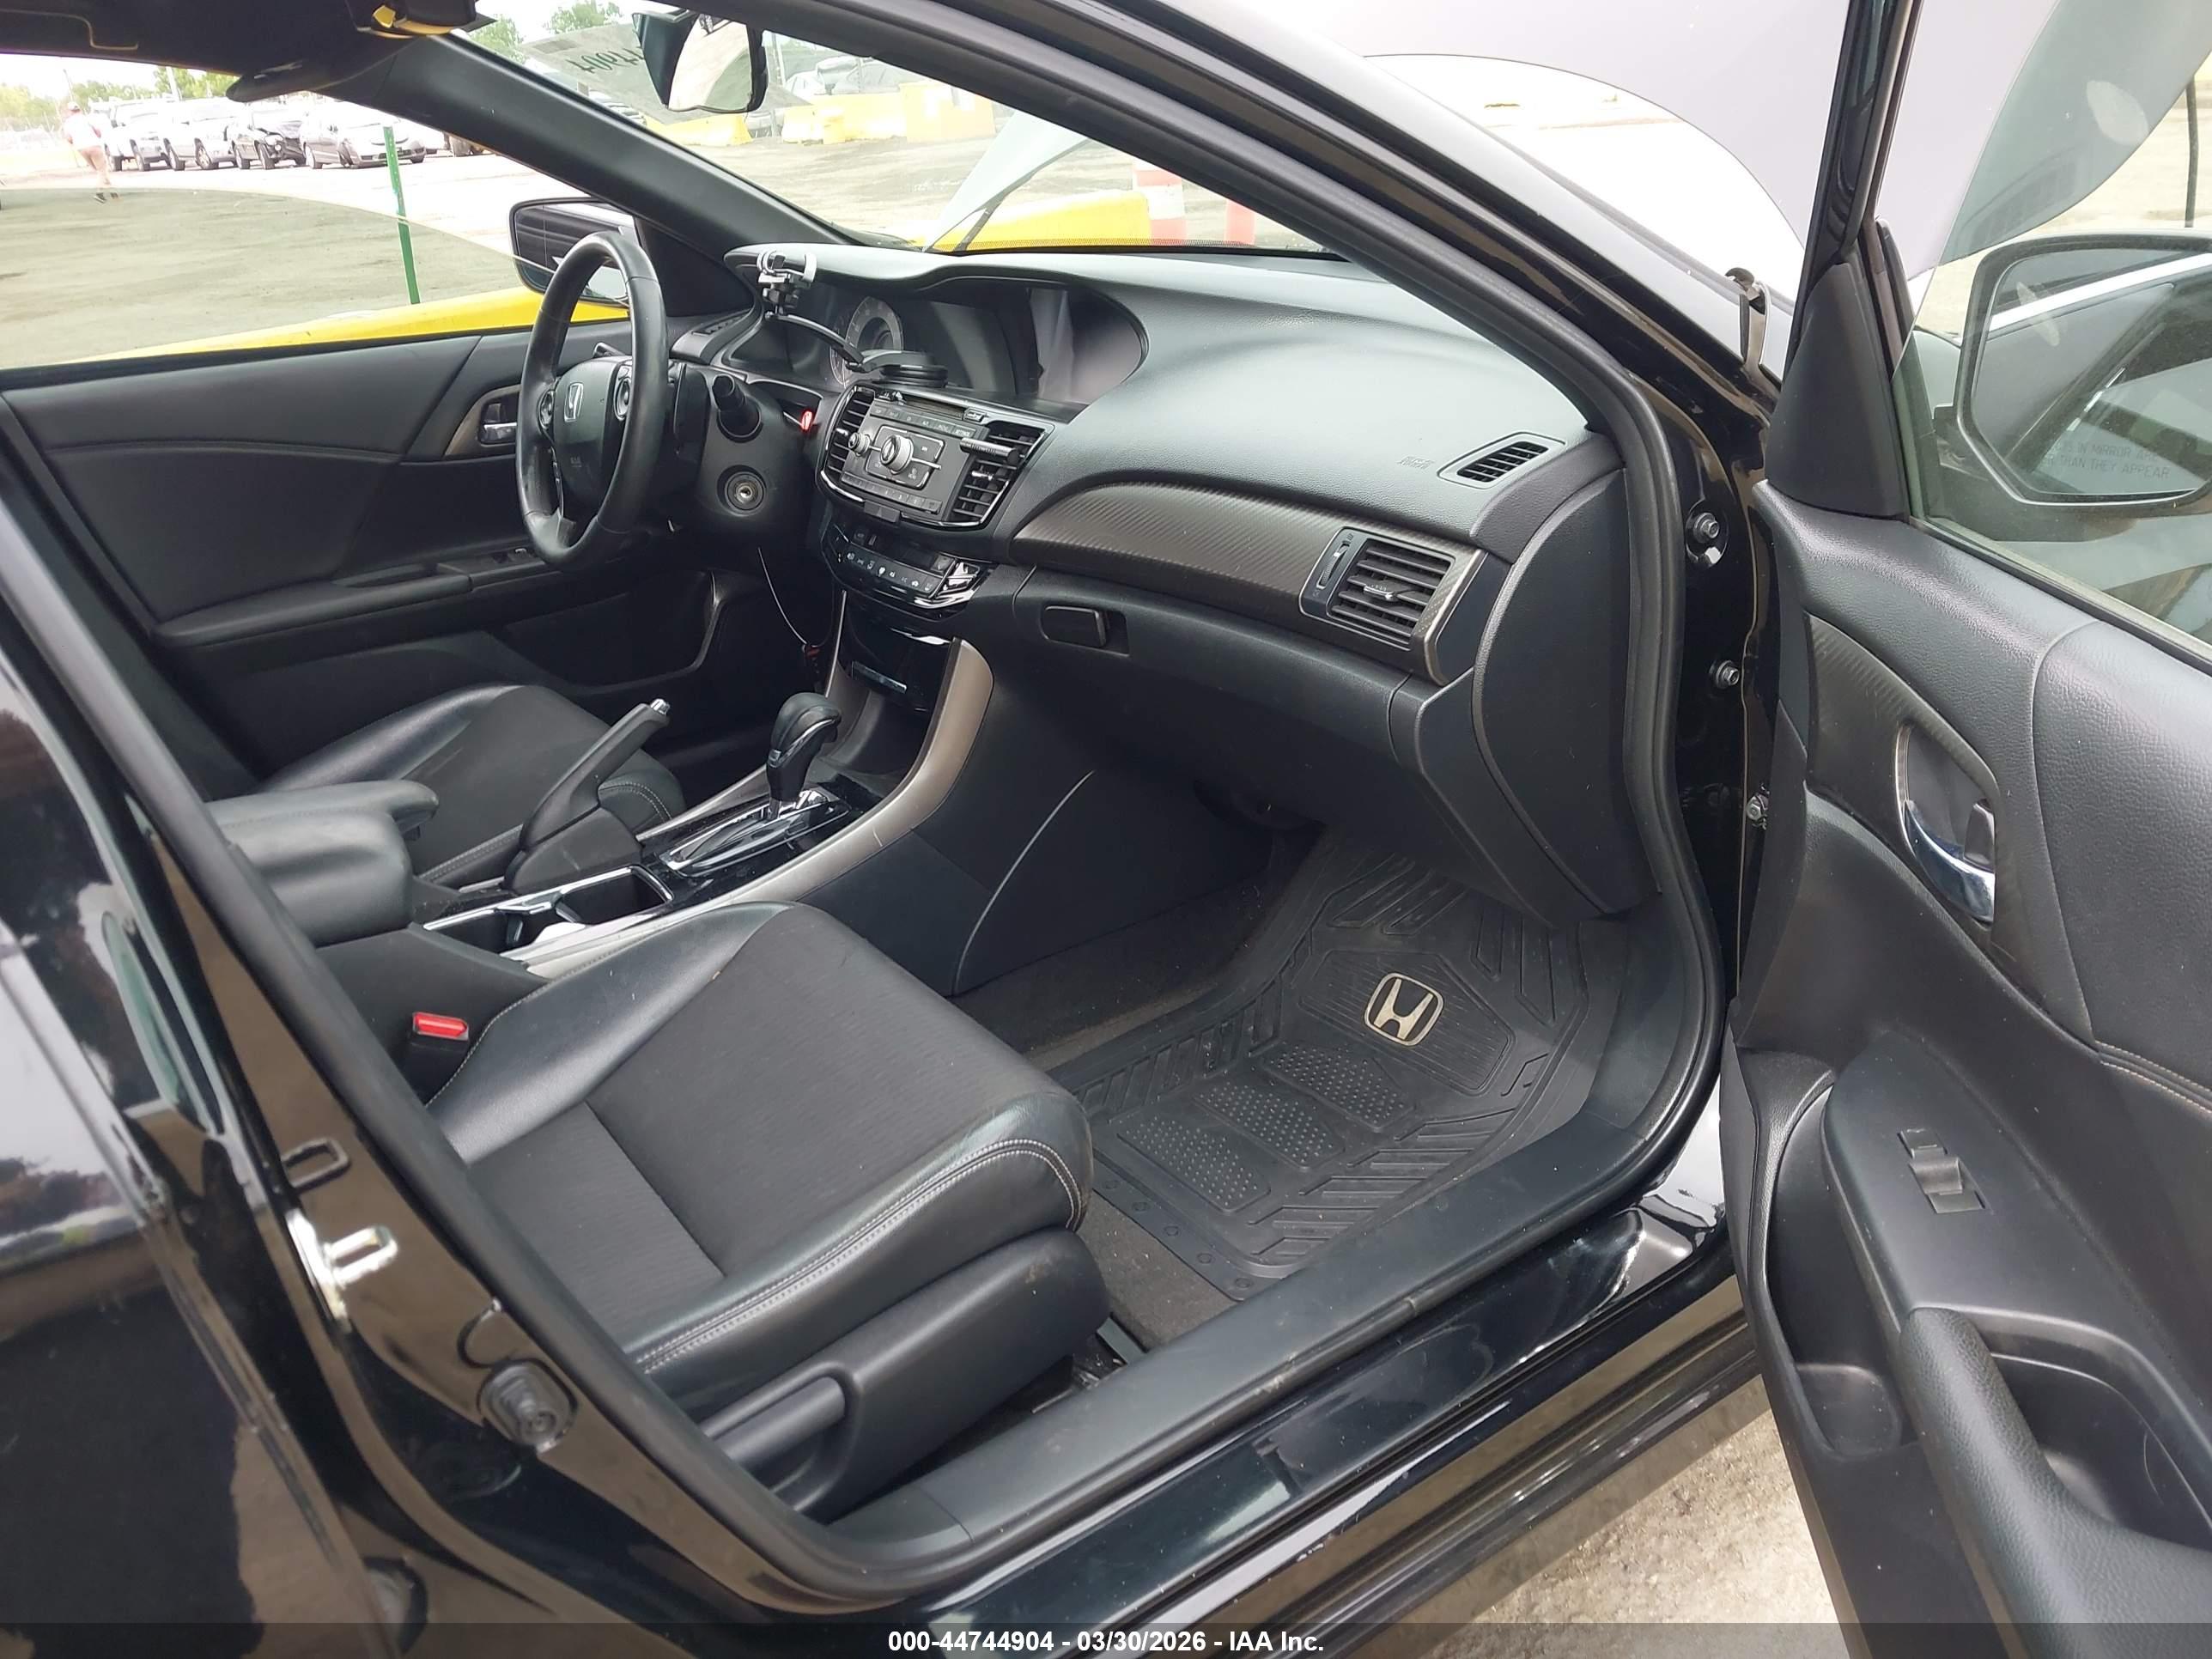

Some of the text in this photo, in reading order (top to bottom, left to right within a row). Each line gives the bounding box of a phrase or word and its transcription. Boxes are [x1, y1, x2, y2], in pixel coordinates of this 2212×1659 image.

[2092, 445, 2131, 459] MIRROR
[2090, 459, 2117, 473] THEY
[2121, 464, 2171, 480] APPEAR
